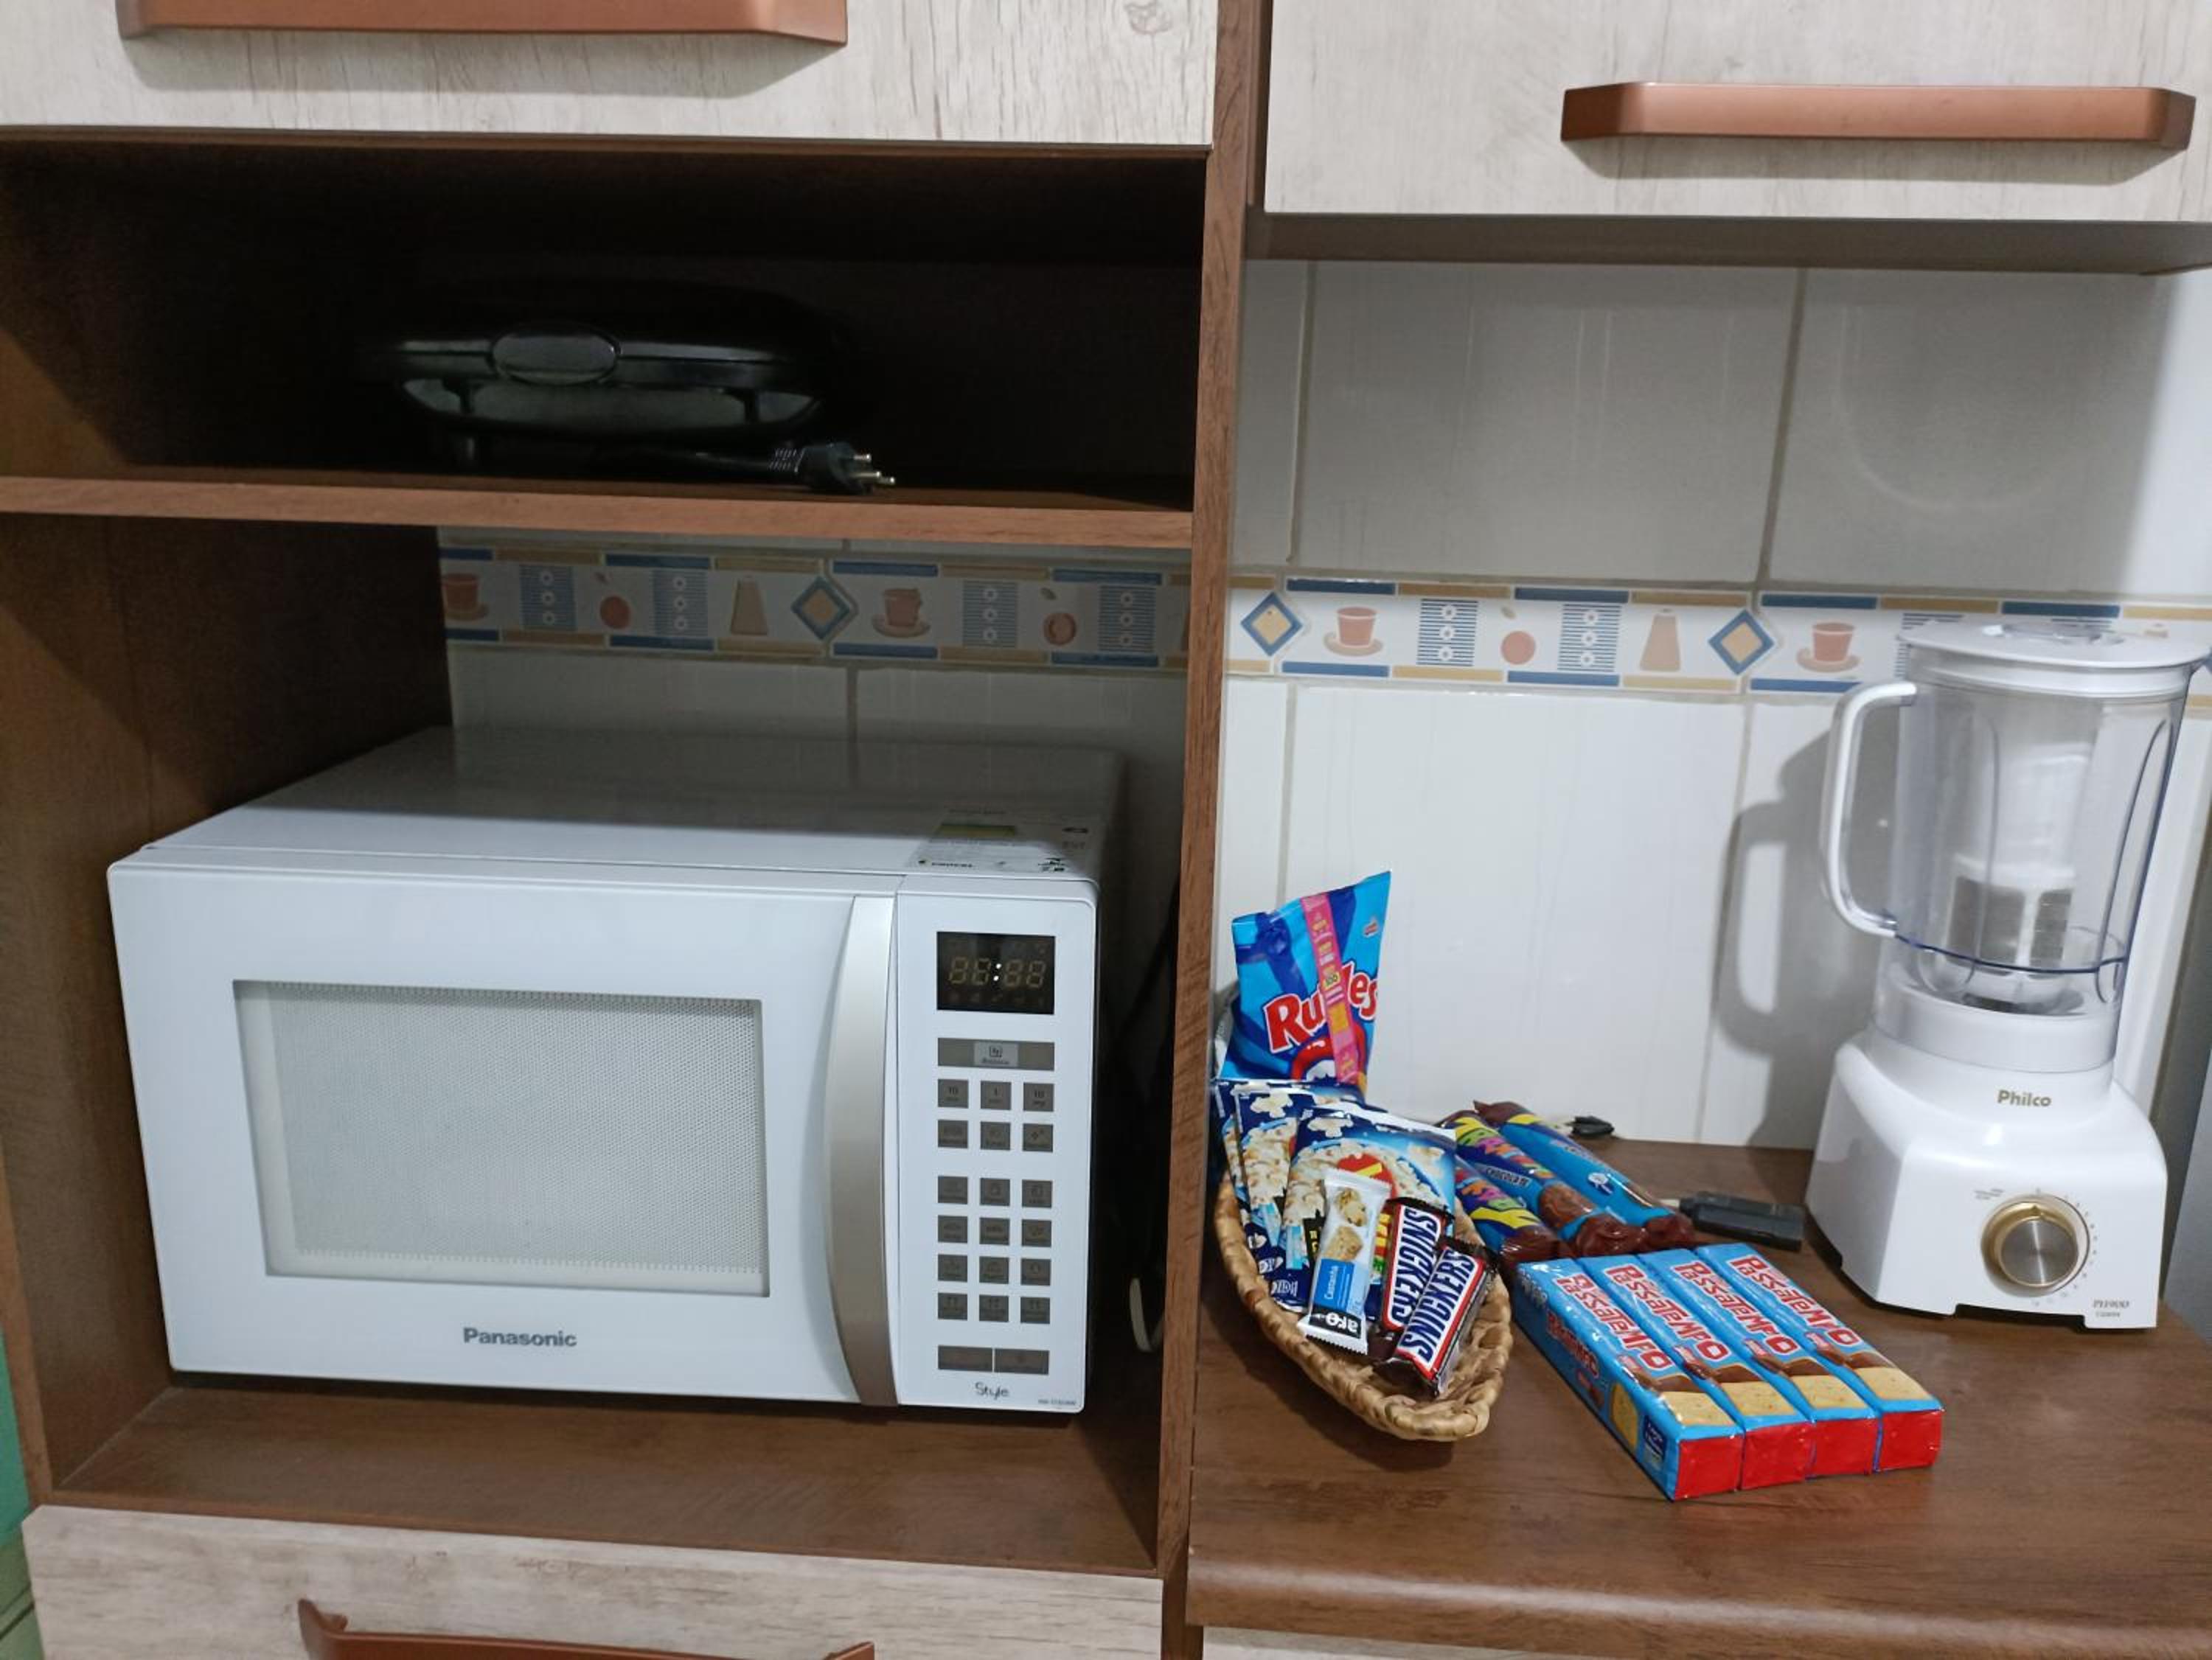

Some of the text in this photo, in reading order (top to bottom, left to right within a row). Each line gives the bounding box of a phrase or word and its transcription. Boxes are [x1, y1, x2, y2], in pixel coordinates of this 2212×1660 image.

[1997, 1089, 2052, 1107] Philco
[1402, 1249, 1475, 1363] SNICKERS
[462, 1327, 577, 1347] Panasonic
[975, 1381, 1010, 1401] Style
